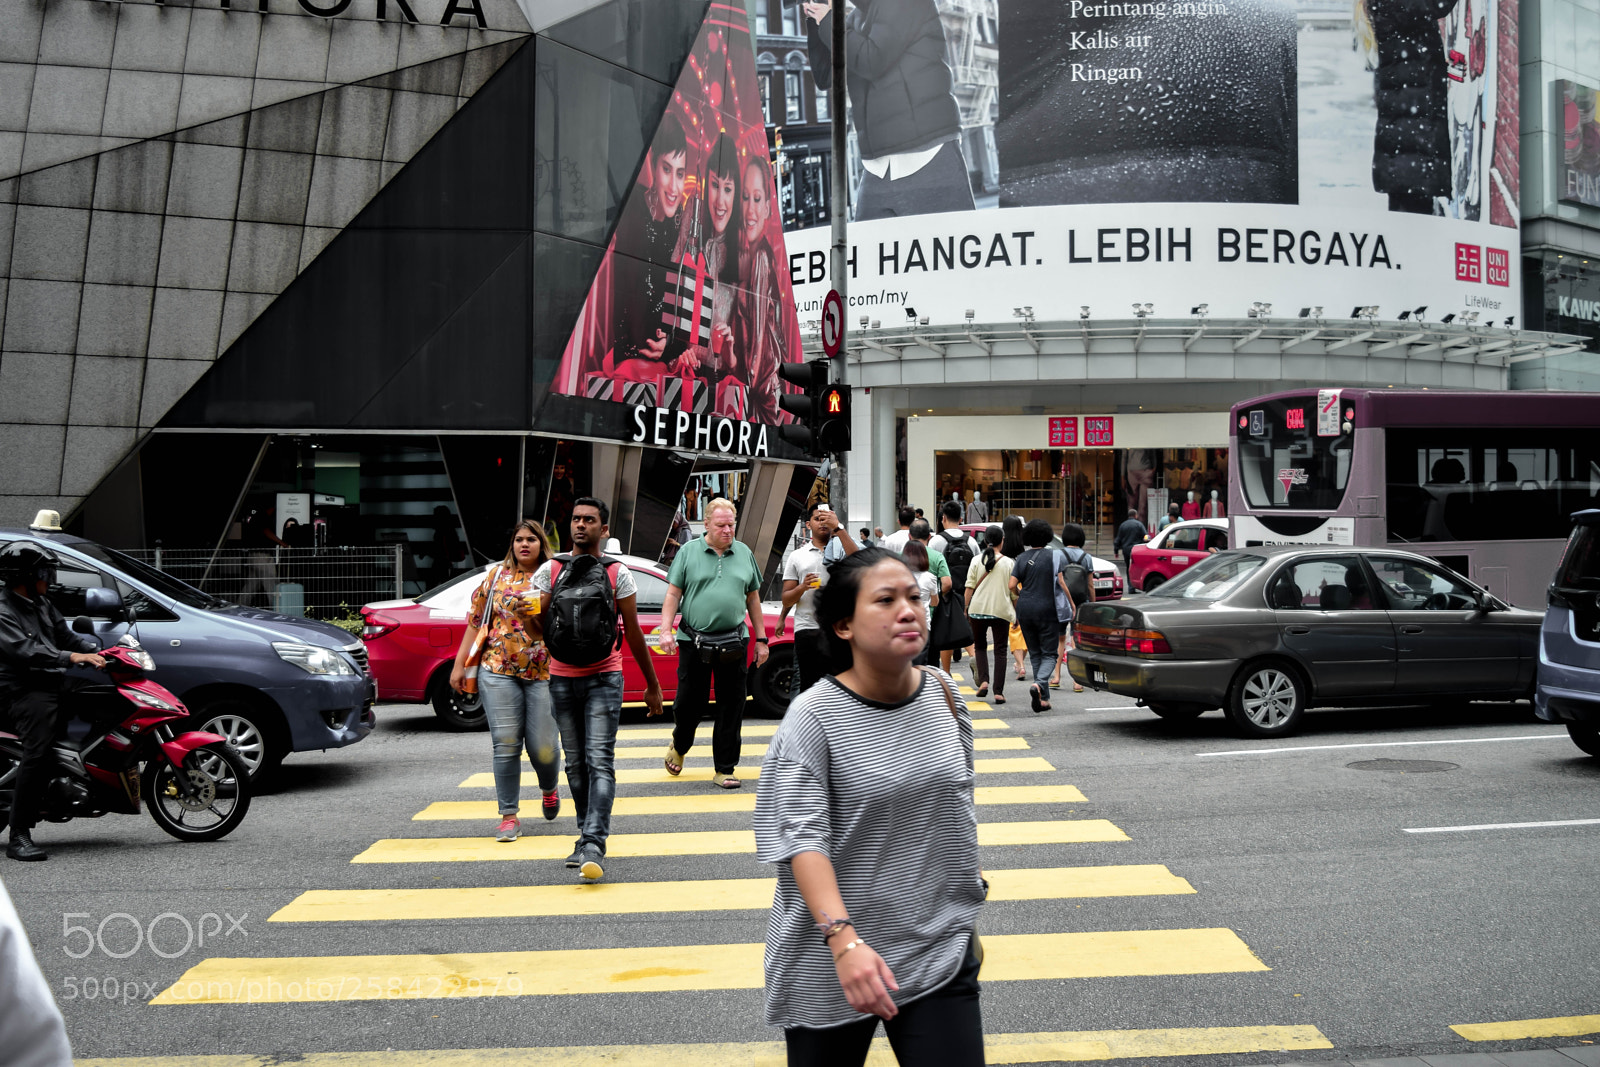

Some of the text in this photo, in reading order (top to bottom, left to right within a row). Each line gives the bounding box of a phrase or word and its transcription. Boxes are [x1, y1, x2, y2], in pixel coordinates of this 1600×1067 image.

[1070, 0, 1228, 19] Perintang angin
[1070, 29, 1153, 51] Kalis air
[1070, 63, 1143, 85] Ringan
[879, 231, 1042, 276] HANGAT.
[1068, 227, 1192, 264] LEBIH
[1217, 227, 1402, 270] BERGAYA.
[1464, 294, 1502, 310] LifeWear
[632, 404, 769, 458] SEPHORA
